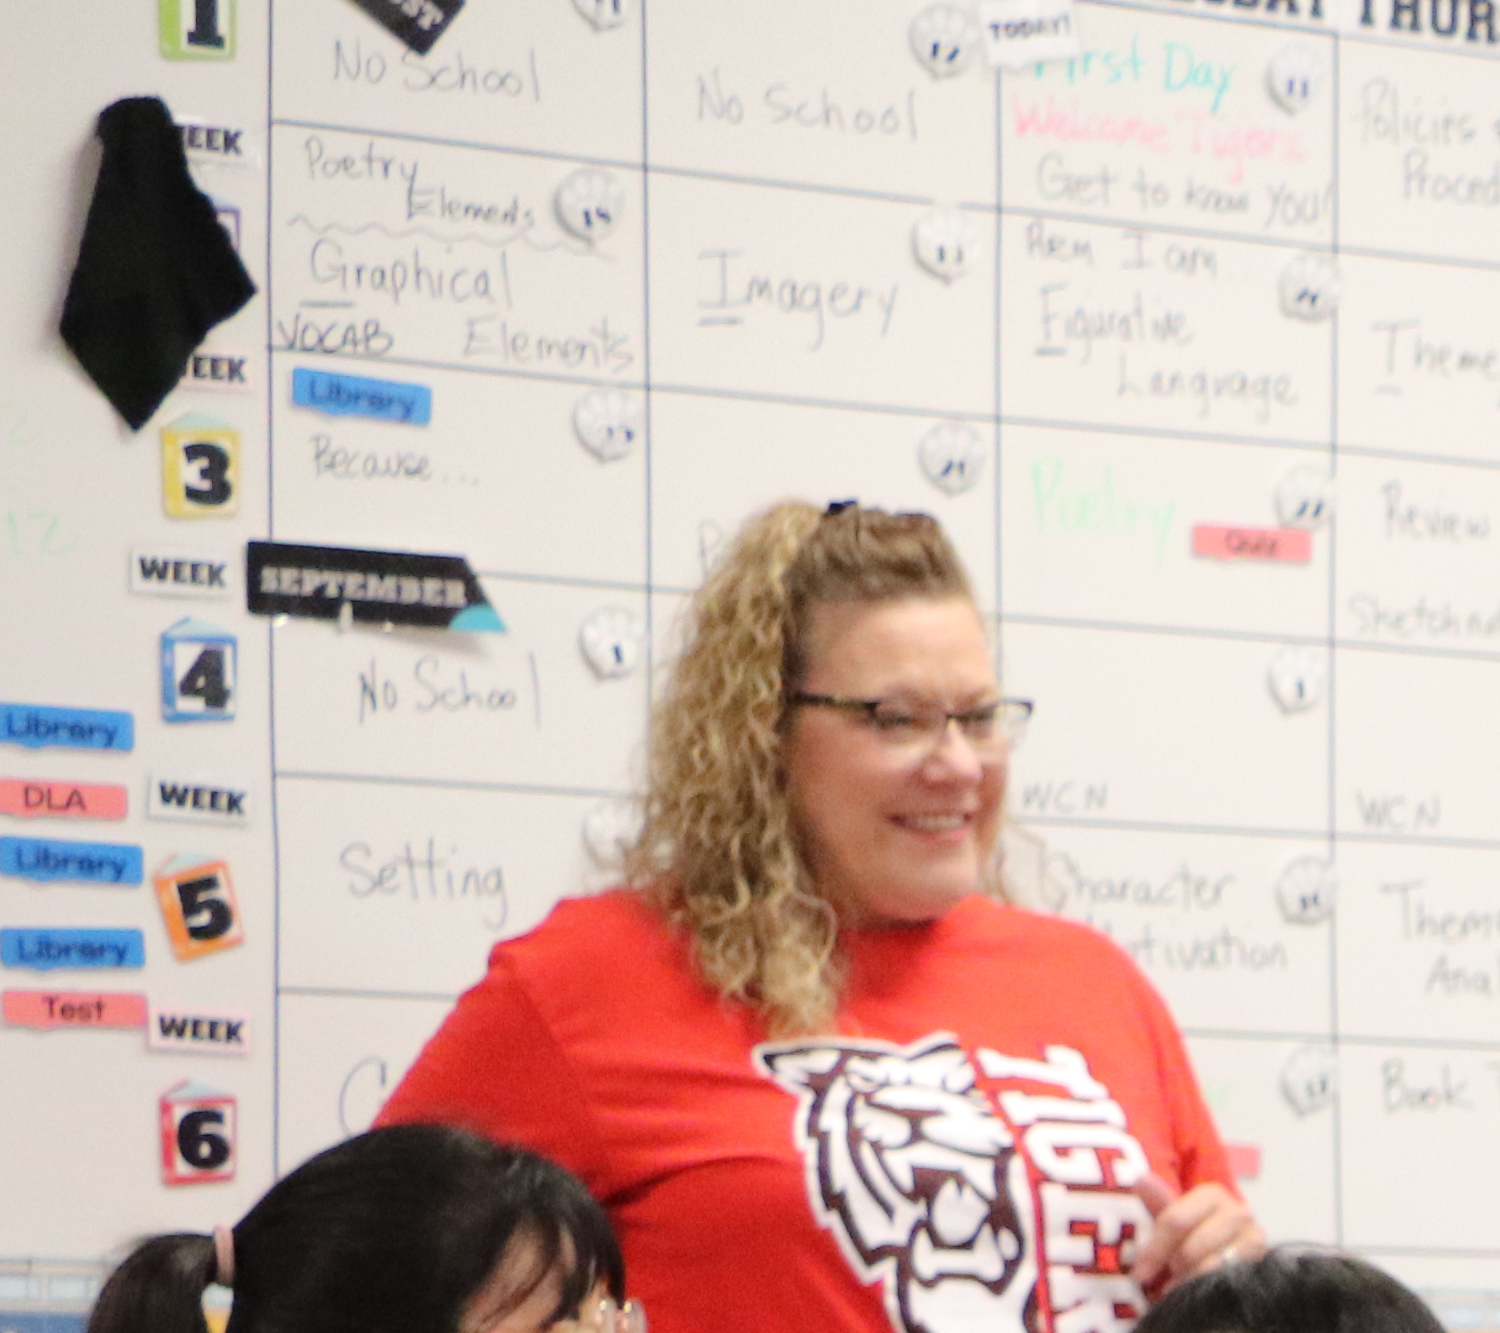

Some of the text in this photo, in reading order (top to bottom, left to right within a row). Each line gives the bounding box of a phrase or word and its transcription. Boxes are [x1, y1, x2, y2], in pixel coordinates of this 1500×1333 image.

[333, 39, 540, 102] No School
[1163, 40, 1239, 114] Day
[697, 66, 918, 142] No School
[1352, 77, 1477, 146] Policies
[304, 138, 420, 193] Poetry
[1037, 152, 1118, 200] Get
[1131, 166, 1171, 207] to
[407, 187, 535, 230] Elements
[310, 238, 514, 308] Graphical
[697, 248, 899, 353] Imagery
[277, 320, 394, 356] VOCAB
[463, 314, 635, 370] Elements
[1040, 281, 1194, 365] Figurative
[308, 377, 420, 420] Library
[1116, 352, 1300, 424] Language
[183, 442, 233, 507] 3
[1379, 477, 1493, 544] Review
[138, 554, 228, 591] WEEK
[260, 563, 467, 606] SEPTEMBER
[177, 648, 229, 711] 4
[357, 651, 543, 732] No School
[6, 711, 118, 749] Library
[23, 785, 87, 812] DLA
[157, 780, 248, 815] WEEK
[16, 845, 126, 884] Library
[337, 836, 511, 932] Setting
[176, 876, 234, 943] 5
[17, 934, 130, 968] Library
[1090, 914, 1289, 973] tivation
[40, 995, 107, 1021] Test
[157, 1014, 246, 1048] WEEK
[173, 1109, 231, 1170] 6
